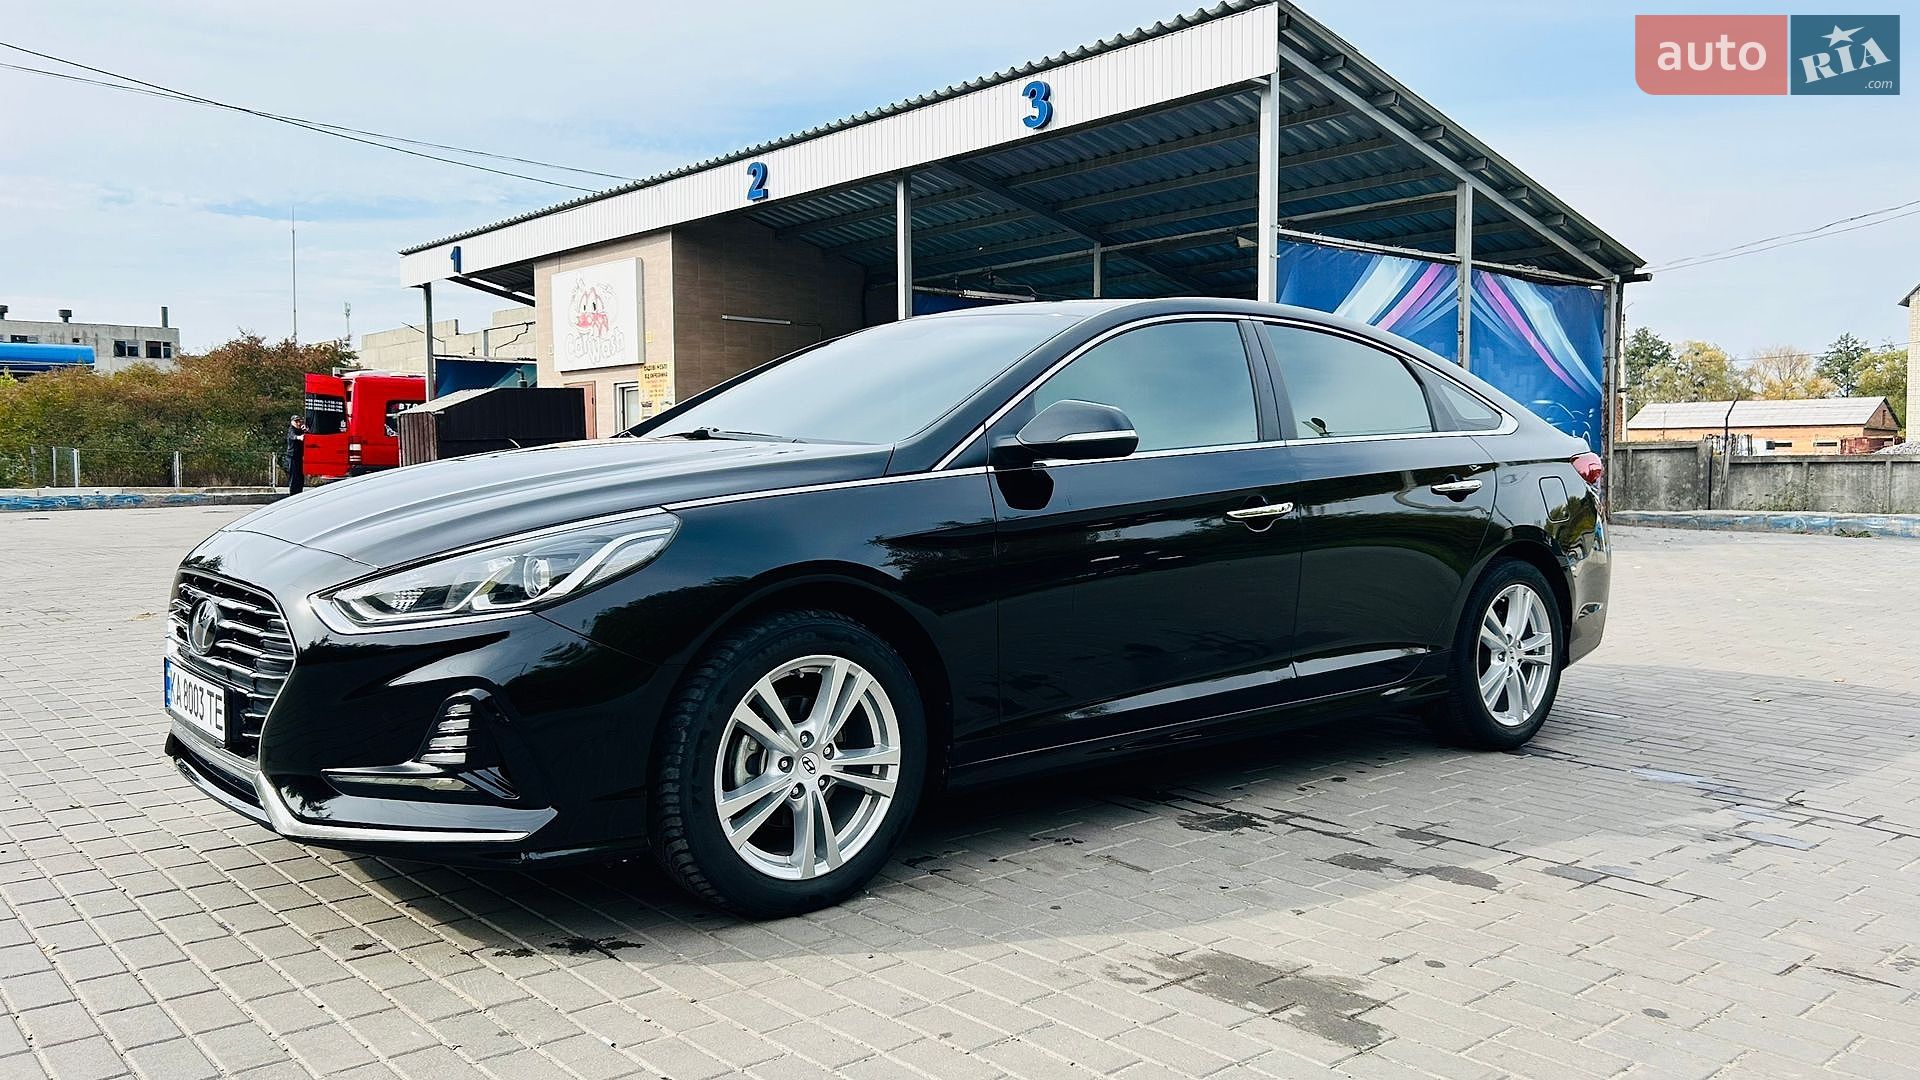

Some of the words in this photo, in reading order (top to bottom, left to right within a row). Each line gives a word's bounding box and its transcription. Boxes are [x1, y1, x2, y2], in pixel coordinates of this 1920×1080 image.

[1022, 81, 1053, 129] 3
[747, 162, 768, 201] 2
[450, 246, 461, 274] 1
[183, 678, 205, 721] 8003
[207, 689, 223, 731] TE
